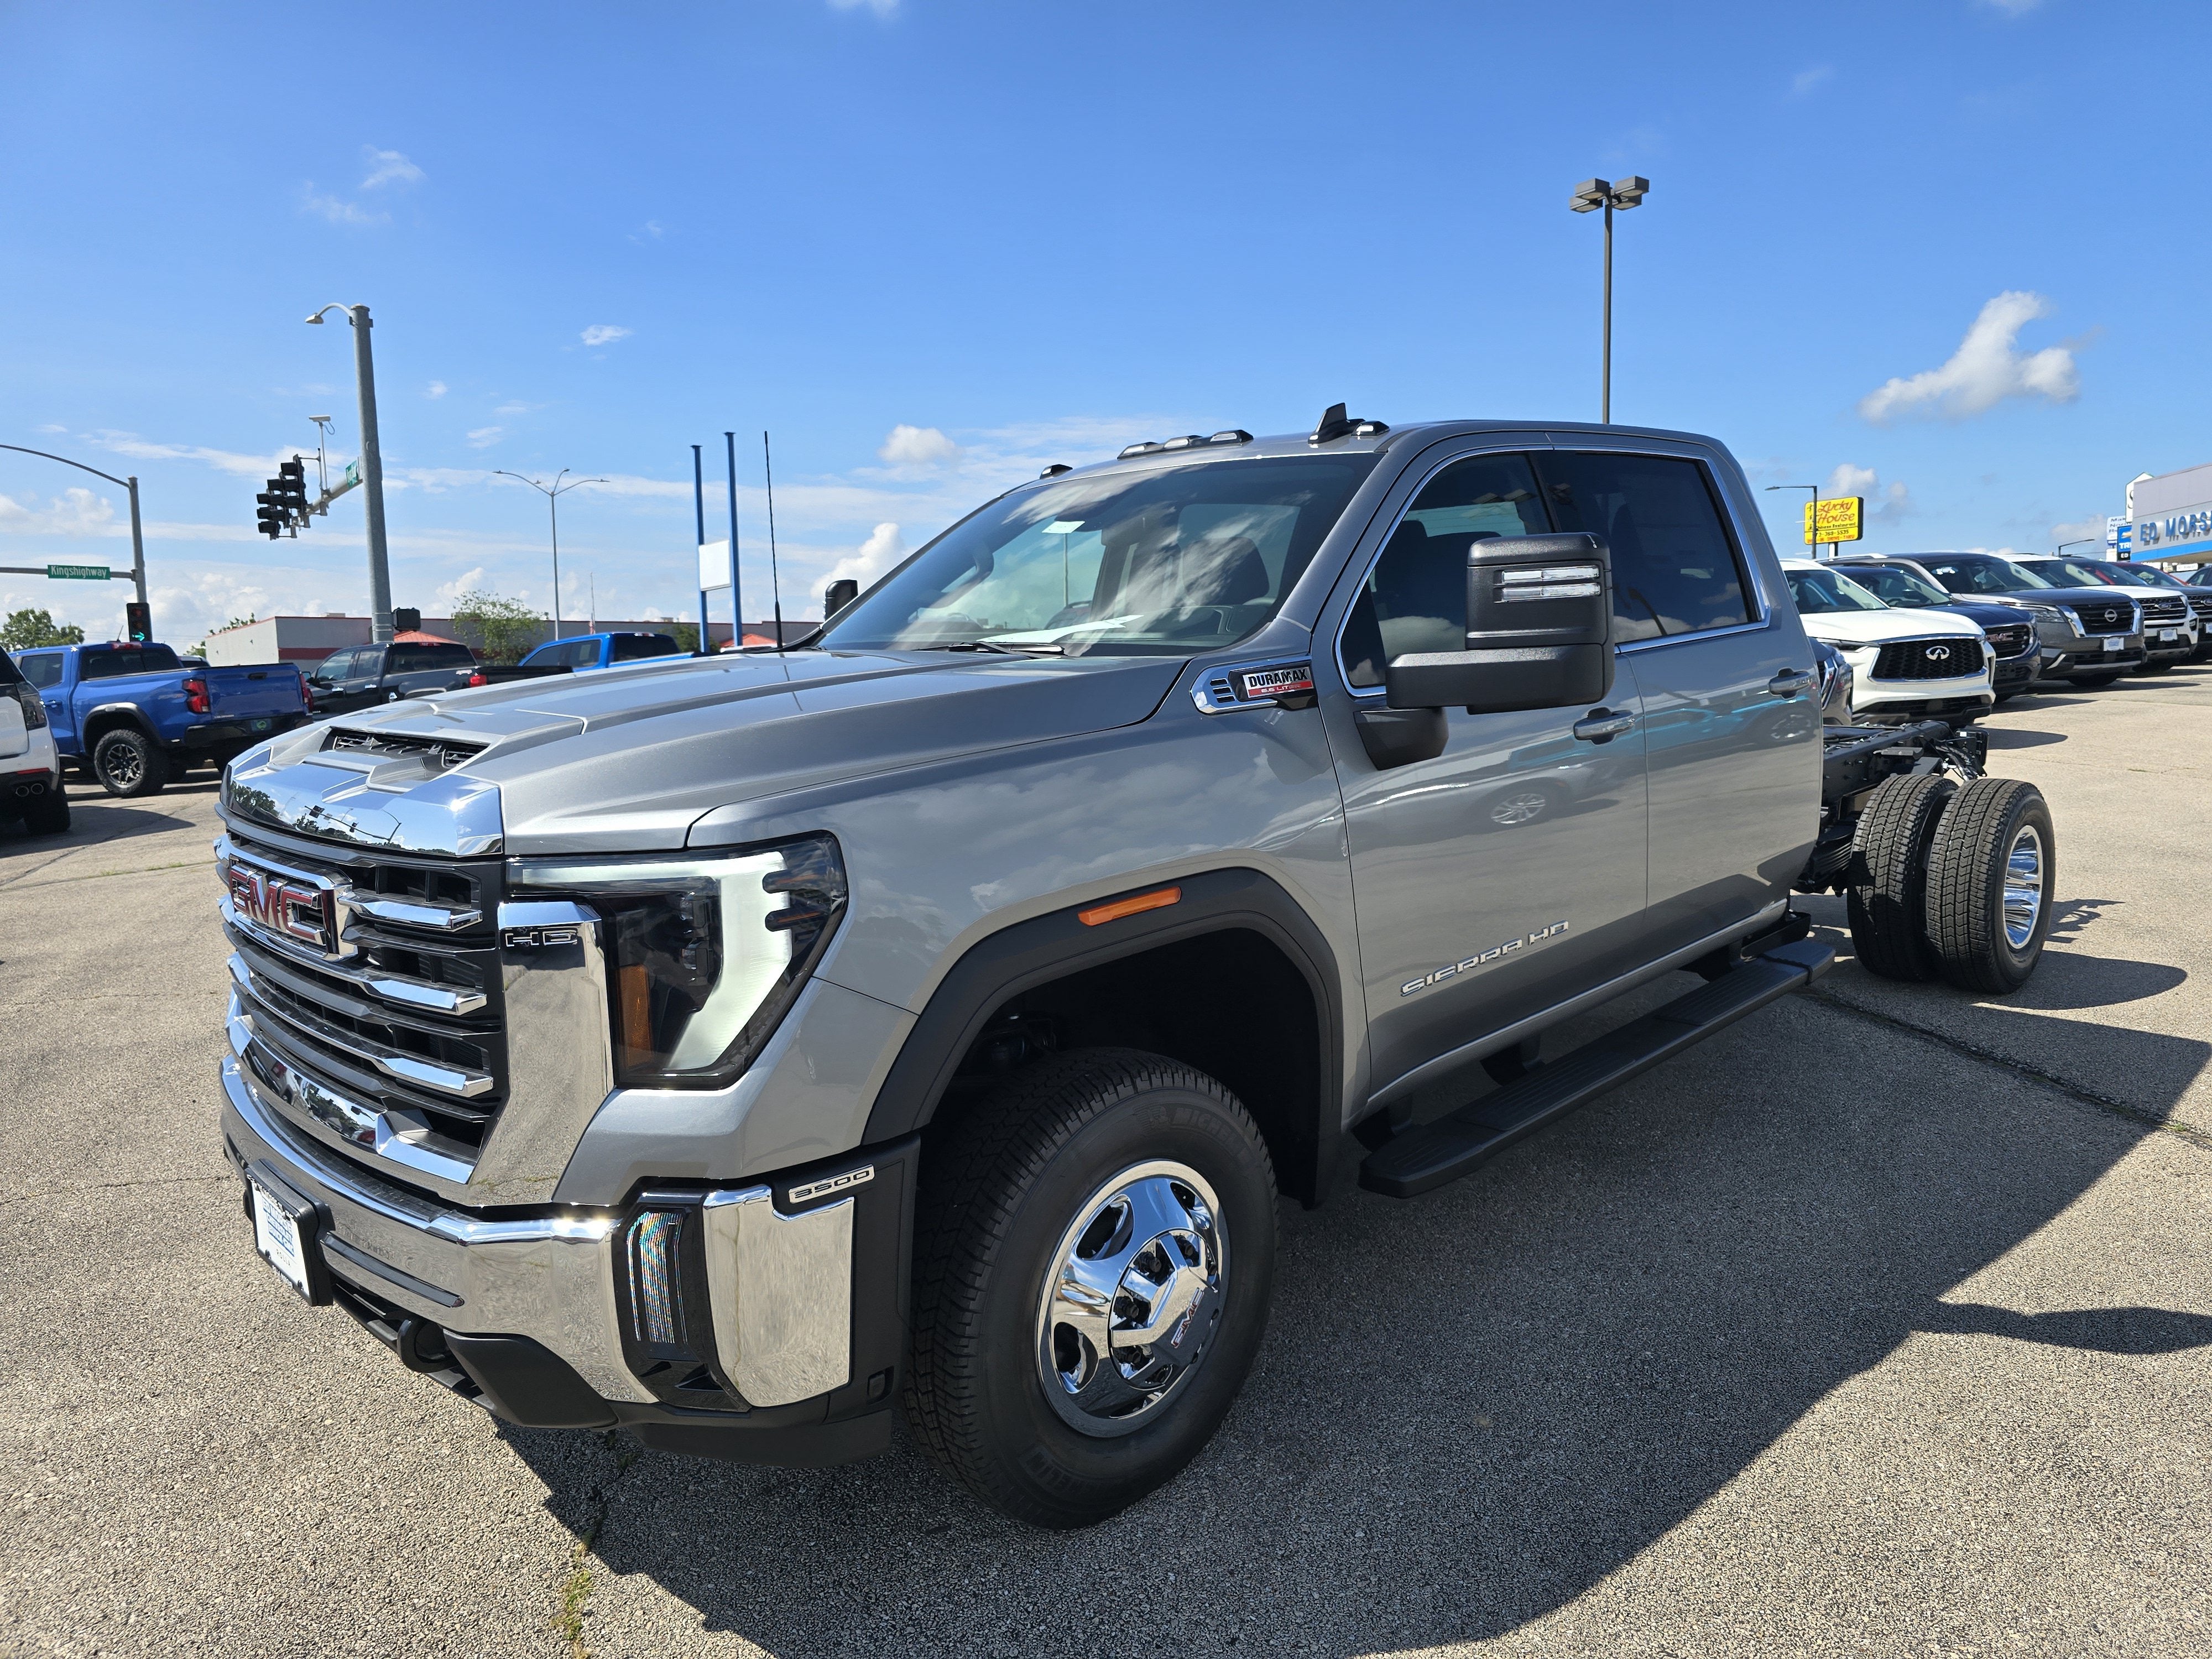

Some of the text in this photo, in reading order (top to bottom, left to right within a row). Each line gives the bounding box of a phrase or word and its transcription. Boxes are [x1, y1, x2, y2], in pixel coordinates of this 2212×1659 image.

[1818, 500, 1854, 513] Lucky
[2140, 522, 2157, 541] ED
[51, 566, 107, 578] Kingshighway
[1248, 669, 1308, 687] DURAMAX
[228, 864, 325, 943] GMC
[505, 930, 578, 947] HD
[1400, 920, 1569, 997] SIERRA HD
[794, 1170, 870, 1199] 3500
[1171, 1287, 1205, 1349] GMC
